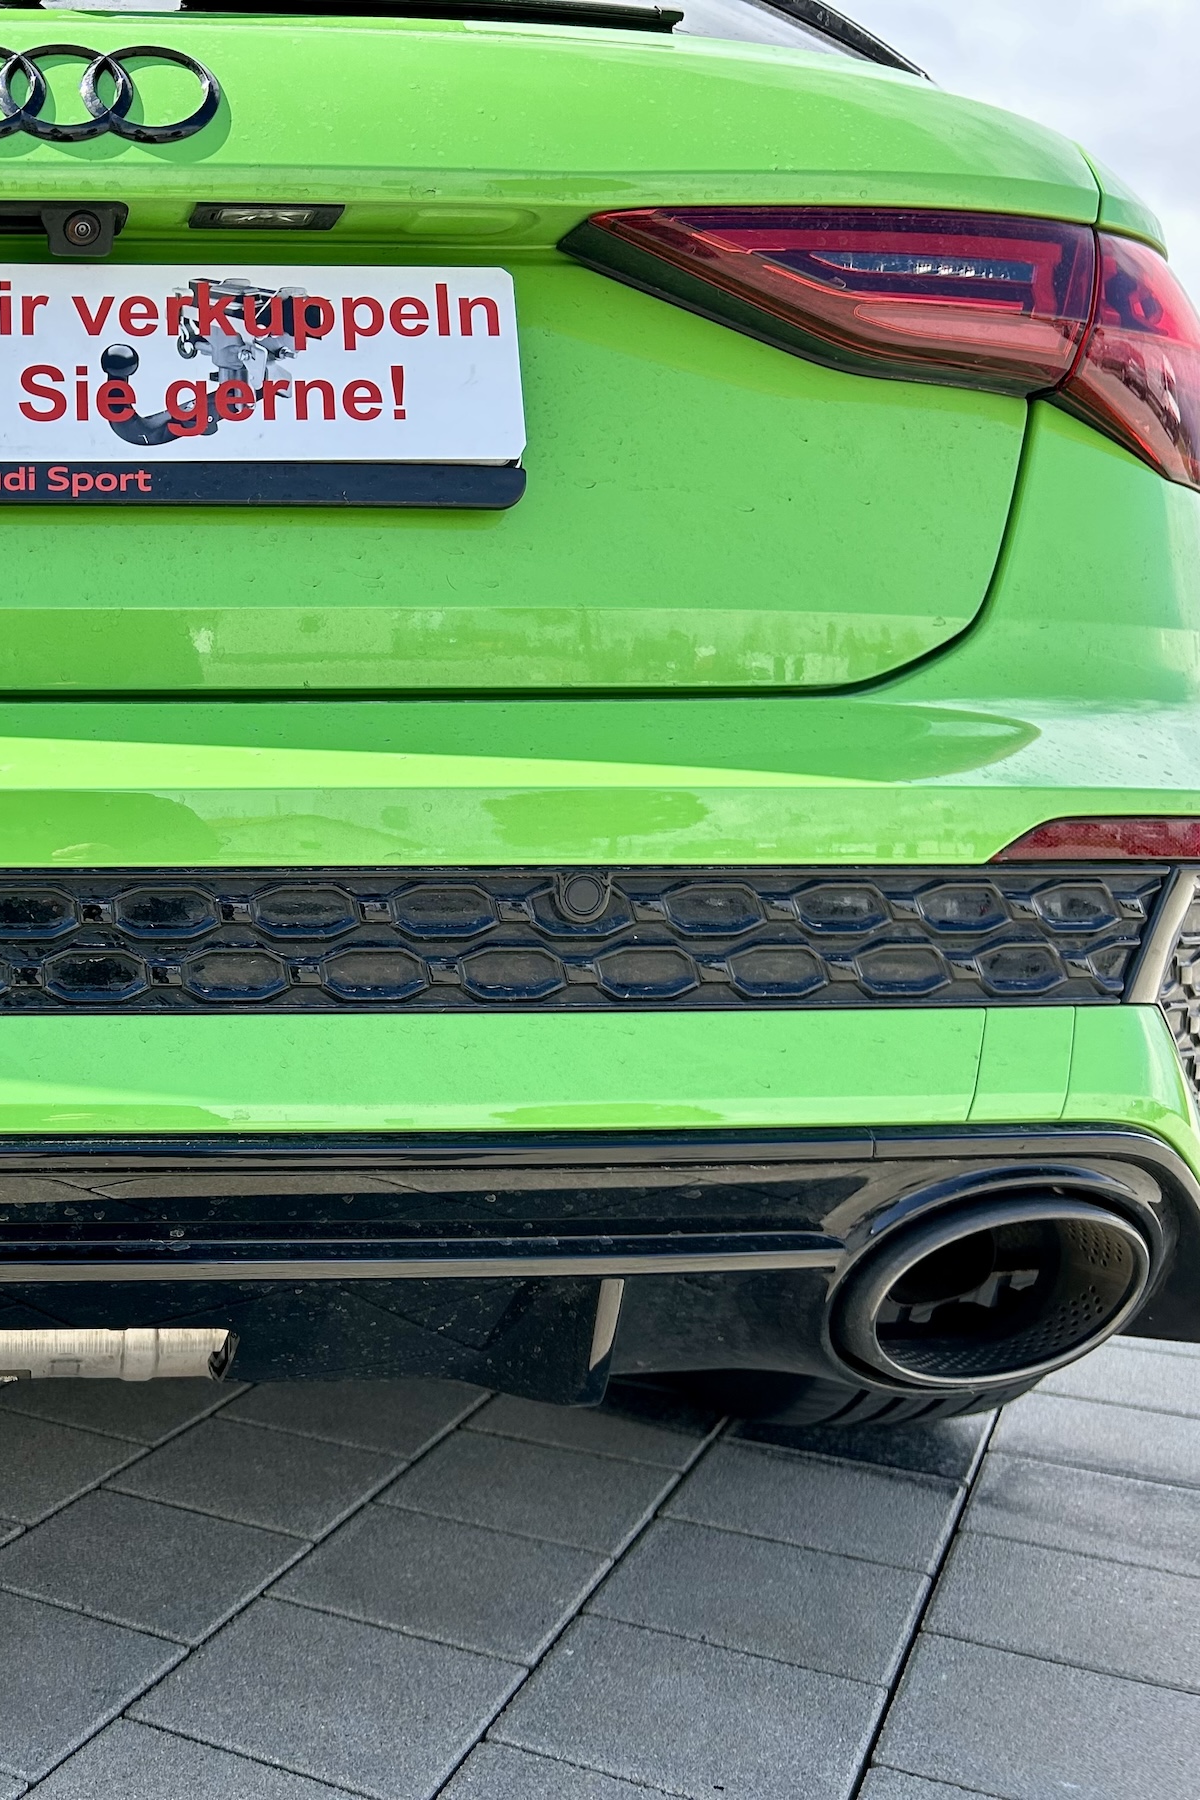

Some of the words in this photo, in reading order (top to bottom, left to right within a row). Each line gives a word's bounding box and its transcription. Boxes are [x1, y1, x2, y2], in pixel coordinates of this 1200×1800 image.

[71, 282, 501, 350] verkuppeln
[18, 364, 136, 422] Sie
[166, 365, 407, 437] gerne!
[46, 466, 152, 498] Sport
